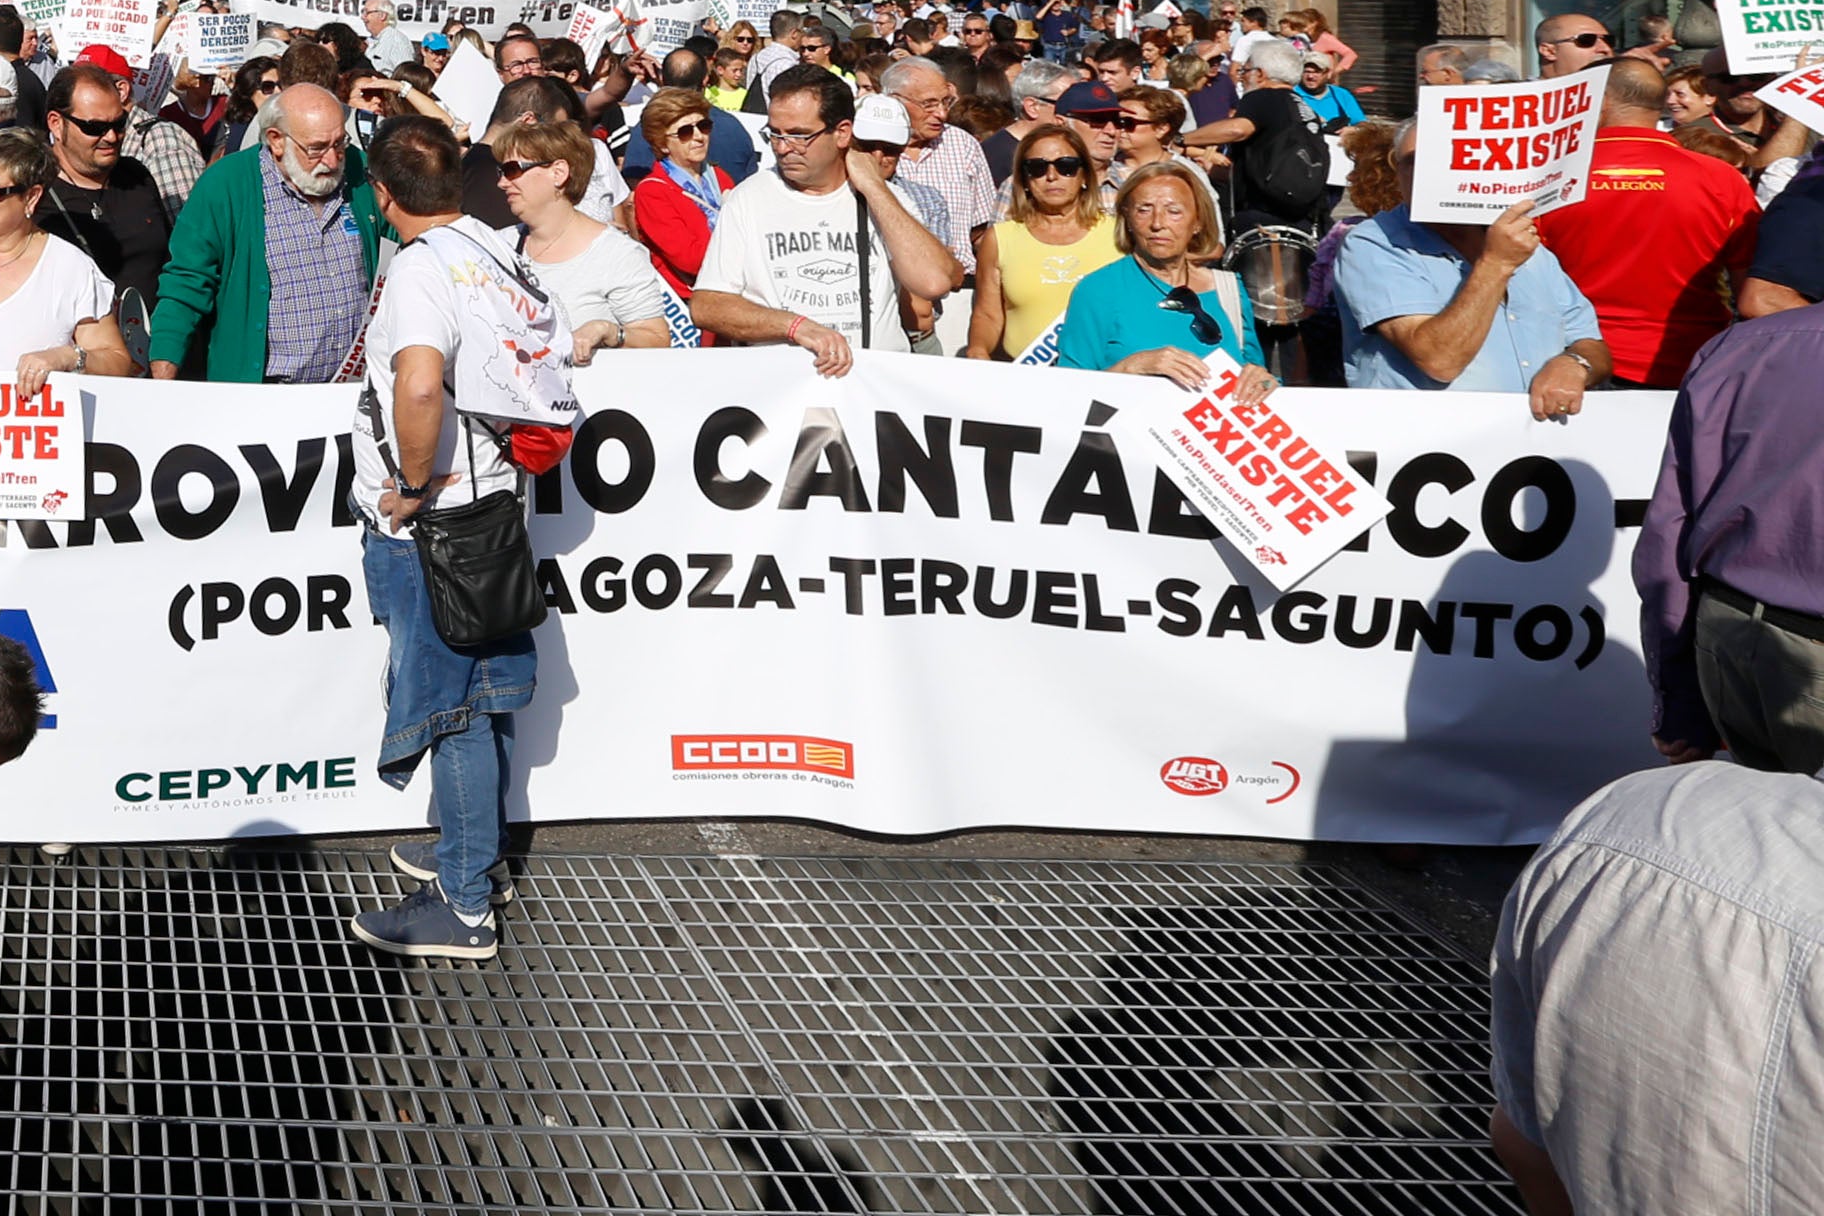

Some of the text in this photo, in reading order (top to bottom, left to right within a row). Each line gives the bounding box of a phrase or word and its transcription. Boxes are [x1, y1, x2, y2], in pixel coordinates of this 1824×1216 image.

[70, 8, 149, 24] LO PUBLICADO
[198, 16, 220, 27] SER
[223, 14, 251, 24] POCOS
[654, 17, 691, 29] SER POCOS
[1742, 9, 1824, 34] EXIST
[86, 21, 127, 34] EN BOE
[202, 27, 217, 36] NO
[220, 25, 249, 36] RESTA
[656, 26, 667, 34] NO
[200, 35, 249, 47] DERECHOS
[1443, 81, 1592, 131] TERUEL
[1450, 120, 1584, 171] EXISTE
[1591, 179, 1666, 191] LA LEGIÓN
[1439, 201, 1484, 209] CORREDOR
[765, 231, 879, 261] TRADE MAK
[802, 262, 852, 281] original
[783, 285, 830, 307] TIFFOSI
[1213, 369, 1357, 517] TERUEL
[1182, 397, 1330, 536] EXISTE
[1171, 429, 1274, 533] #NoPierdaselTren
[168, 574, 352, 652] (POR
[682, 741, 797, 764] CCOO
[115, 757, 356, 803] CEPYME
[672, 770, 855, 790] comisiones obreras de Aragón
[1167, 760, 1280, 787] UGT Aragón
[113, 790, 357, 813] PYMES Y AUTÓNOMOS DE TERUEL
